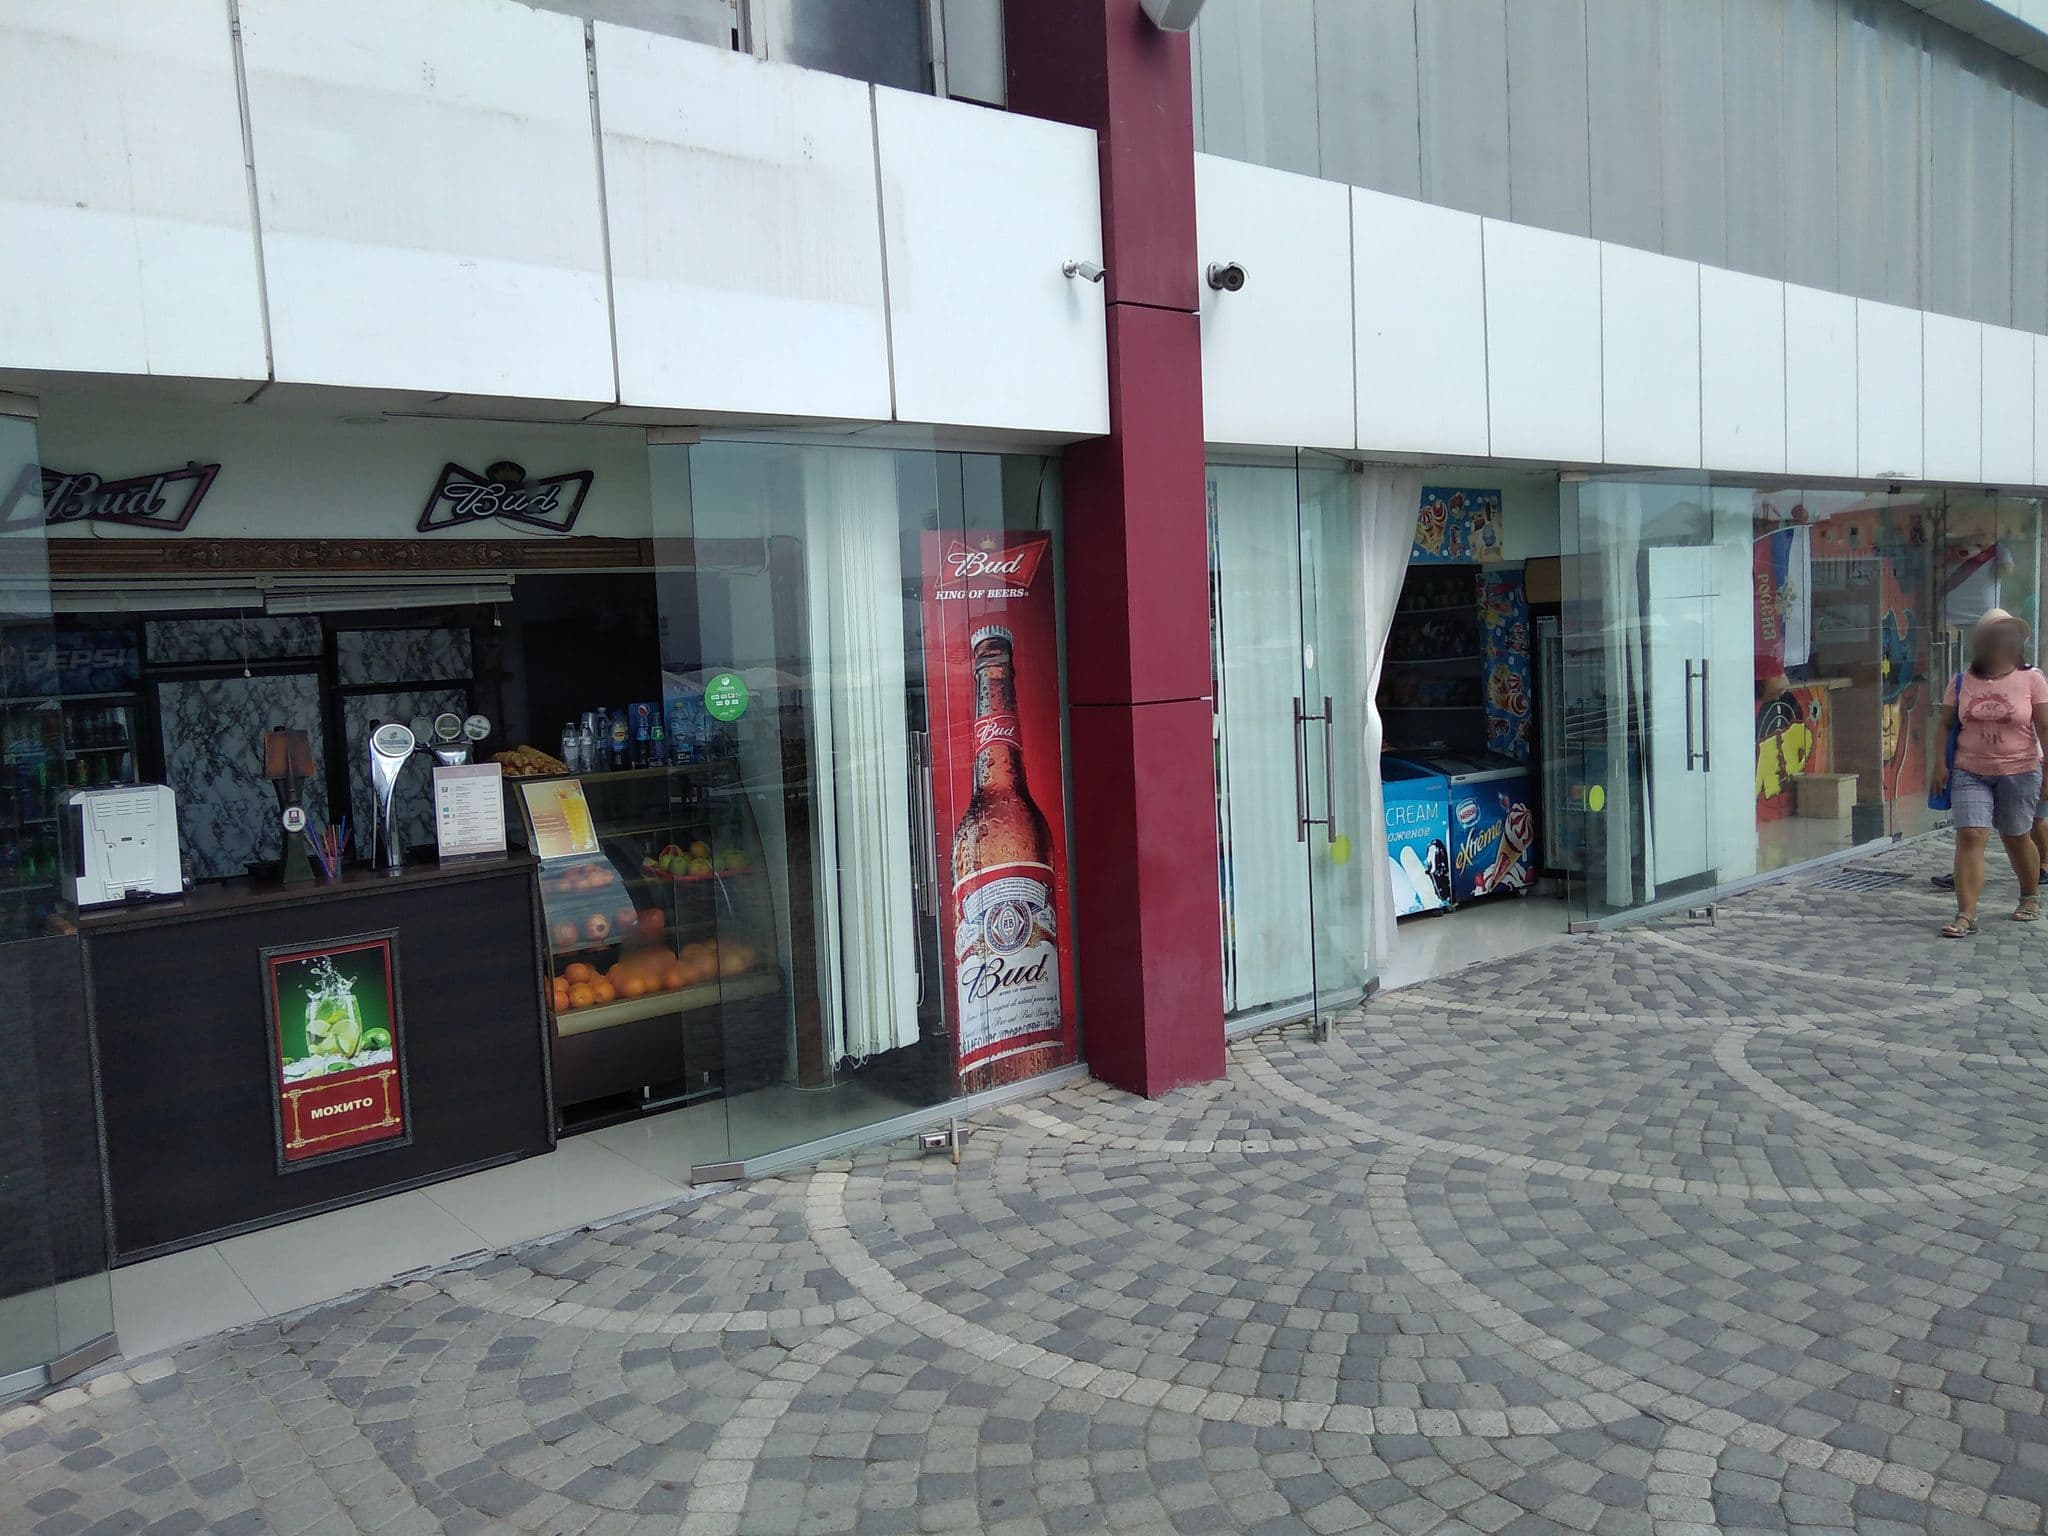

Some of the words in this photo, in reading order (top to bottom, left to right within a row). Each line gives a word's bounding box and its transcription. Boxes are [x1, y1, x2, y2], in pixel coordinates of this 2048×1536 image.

[31, 472, 166, 519] Bud
[442, 482, 561, 517] Bud
[947, 551, 1025, 577] Bud
[935, 590, 966, 600] KING
[968, 590, 985, 599] OF
[987, 588, 1025, 598] BEERS
[1757, 573, 1777, 640] РОССИЯ
[976, 722, 1015, 744] Bud
[1385, 802, 1438, 827] CREAM
[962, 954, 1048, 1004] Bud
[311, 1097, 373, 1119] МОХИТО
